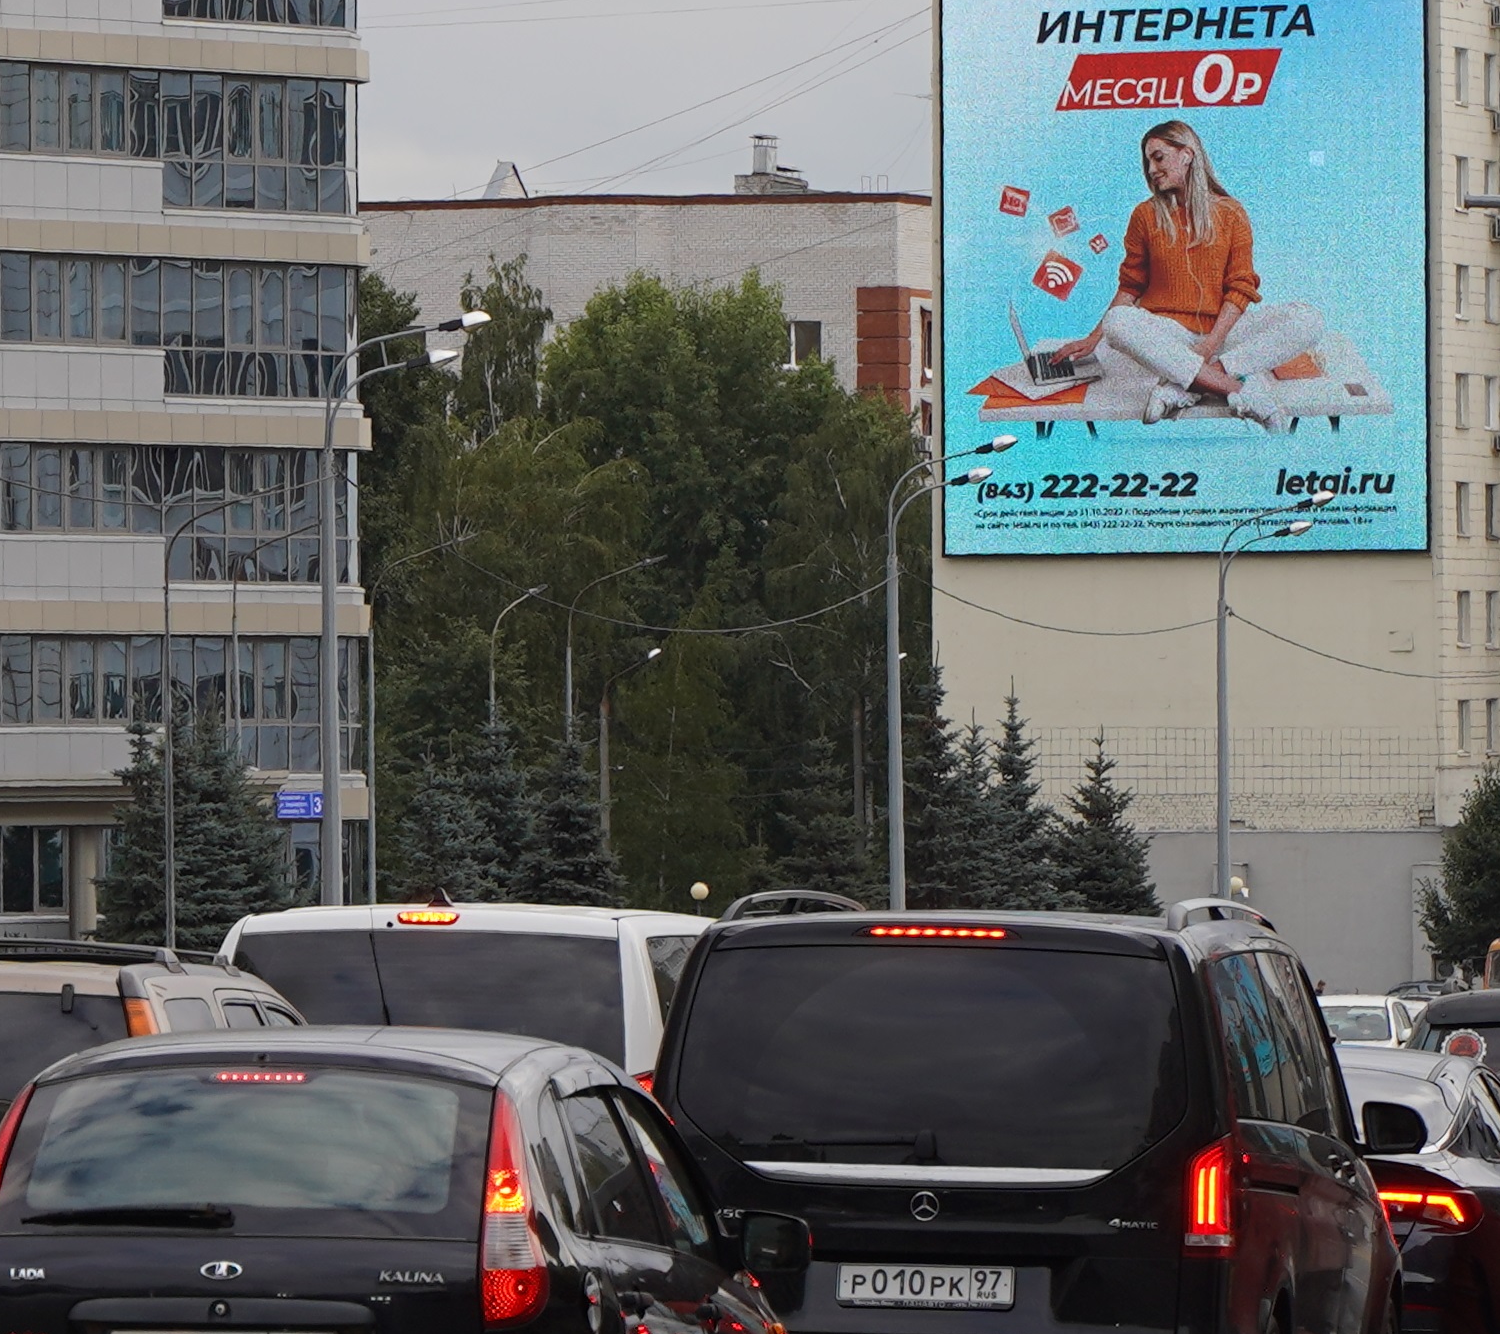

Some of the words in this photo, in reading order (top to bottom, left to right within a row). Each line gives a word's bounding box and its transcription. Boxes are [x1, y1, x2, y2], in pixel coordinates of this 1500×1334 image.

[1036, 4, 1315, 44] ИНТЕРНЕТА
[1061, 76, 1185, 108] МЕСЯЦ
[977, 481, 1034, 503] (843)
[1040, 472, 1199, 499] 222-22-22
[1275, 467, 1396, 496] letai.ru
[1107, 1217, 1159, 1229] 4MATIC
[9, 1267, 46, 1280] LADA
[378, 1270, 445, 1284] KALINA
[974, 1270, 1003, 1291] 97
[976, 1291, 998, 1300] RUS
